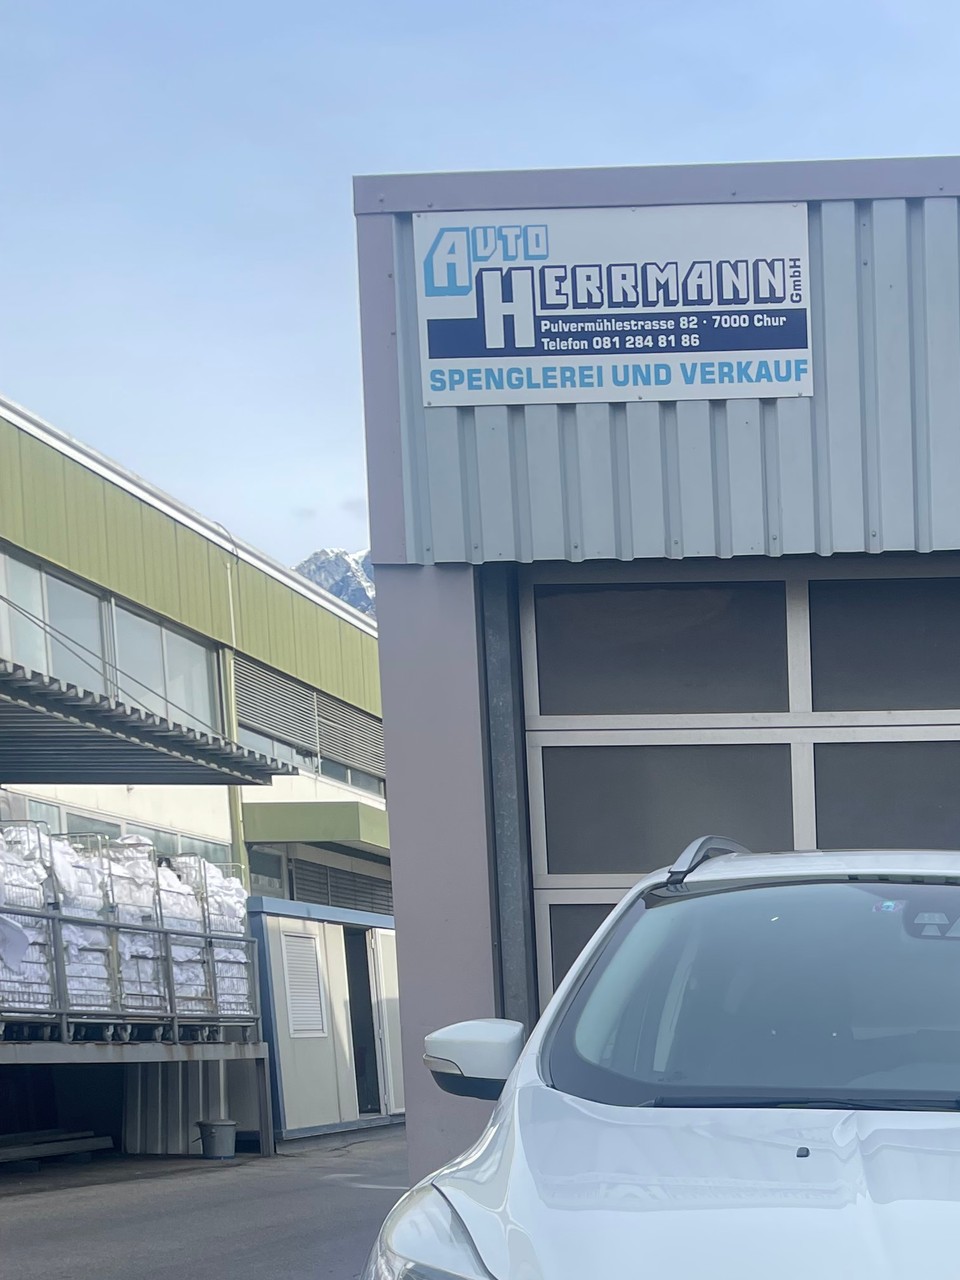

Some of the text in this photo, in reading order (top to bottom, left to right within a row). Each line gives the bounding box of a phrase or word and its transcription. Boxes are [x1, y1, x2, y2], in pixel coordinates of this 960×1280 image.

[423, 224, 549, 297] AUTO
[788, 258, 802, 303] GmbH
[475, 258, 786, 349] HERRMANN
[541, 319, 675, 333] Pulvermühlestrasse
[679, 316, 698, 329] 82
[712, 315, 749, 328] 7000
[753, 313, 787, 327] Chur
[541, 334, 700, 350] Telefon 081 284 81 86
[430, 359, 808, 392] SPENGLEREI UND VERKAUF
